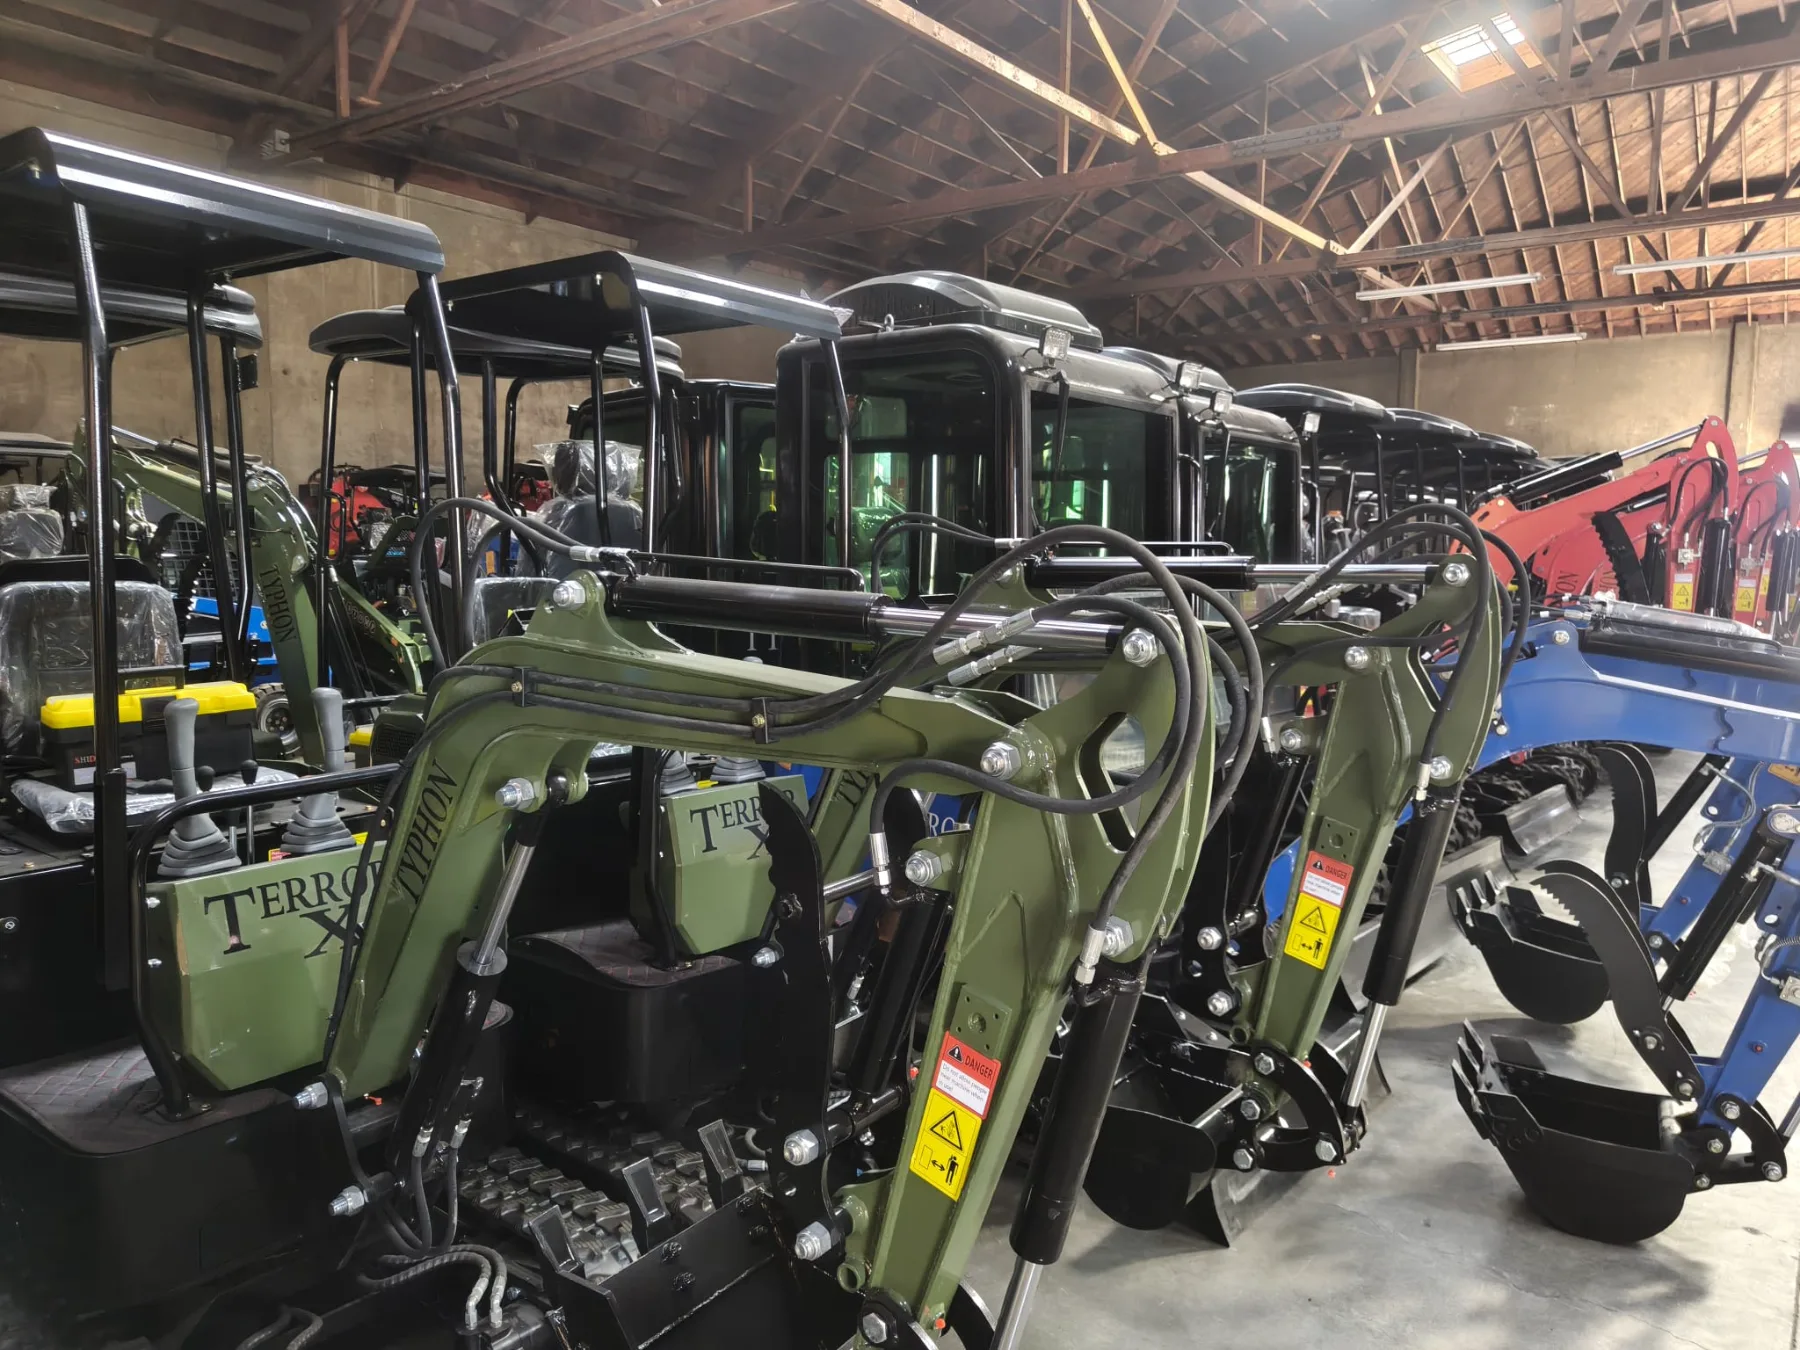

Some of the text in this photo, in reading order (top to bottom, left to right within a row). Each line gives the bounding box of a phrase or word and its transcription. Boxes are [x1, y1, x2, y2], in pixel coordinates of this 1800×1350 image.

[259, 564, 298, 642] TYPHON
[396, 757, 457, 904] TYPHON
[965, 1055, 993, 1081] DANGER
